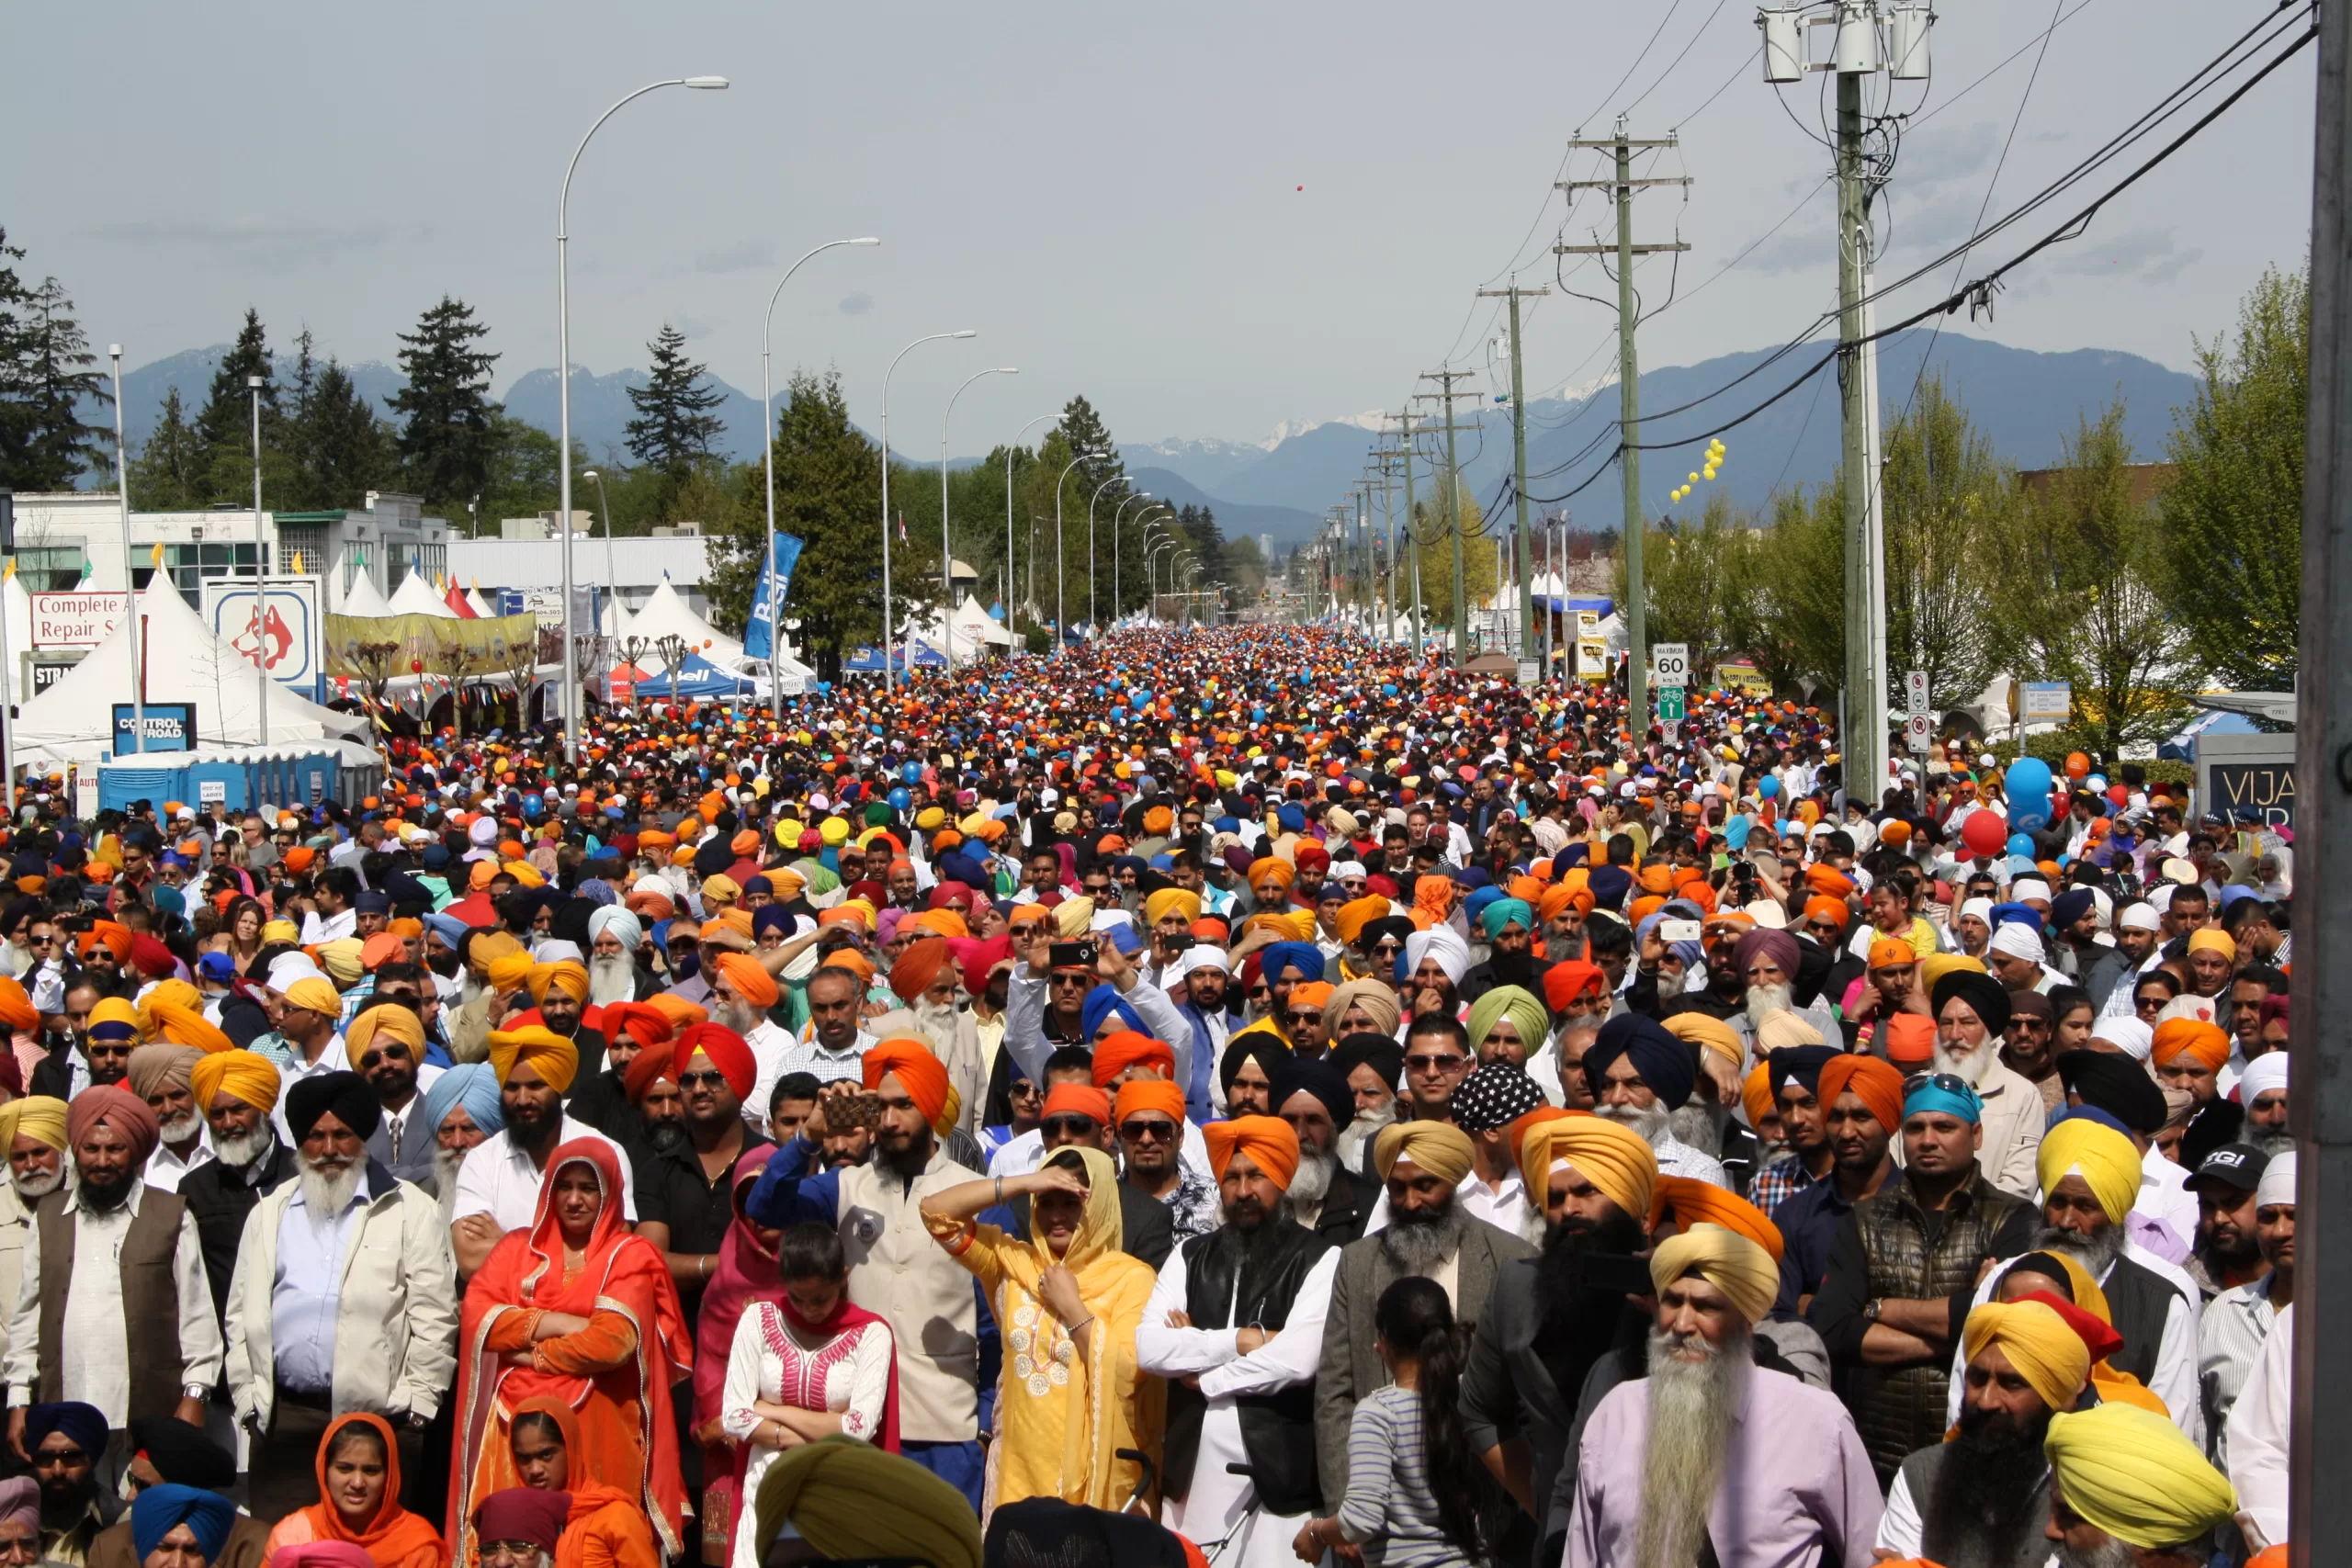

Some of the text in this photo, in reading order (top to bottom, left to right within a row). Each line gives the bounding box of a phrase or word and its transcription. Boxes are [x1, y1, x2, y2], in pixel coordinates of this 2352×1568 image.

[753, 570, 789, 624] Bell
[39, 596, 118, 617] Complete
[40, 620, 96, 641] Repair
[1657, 658, 1684, 673] 60
[119, 718, 182, 729] CONTROL
[147, 728, 182, 739] ROAD
